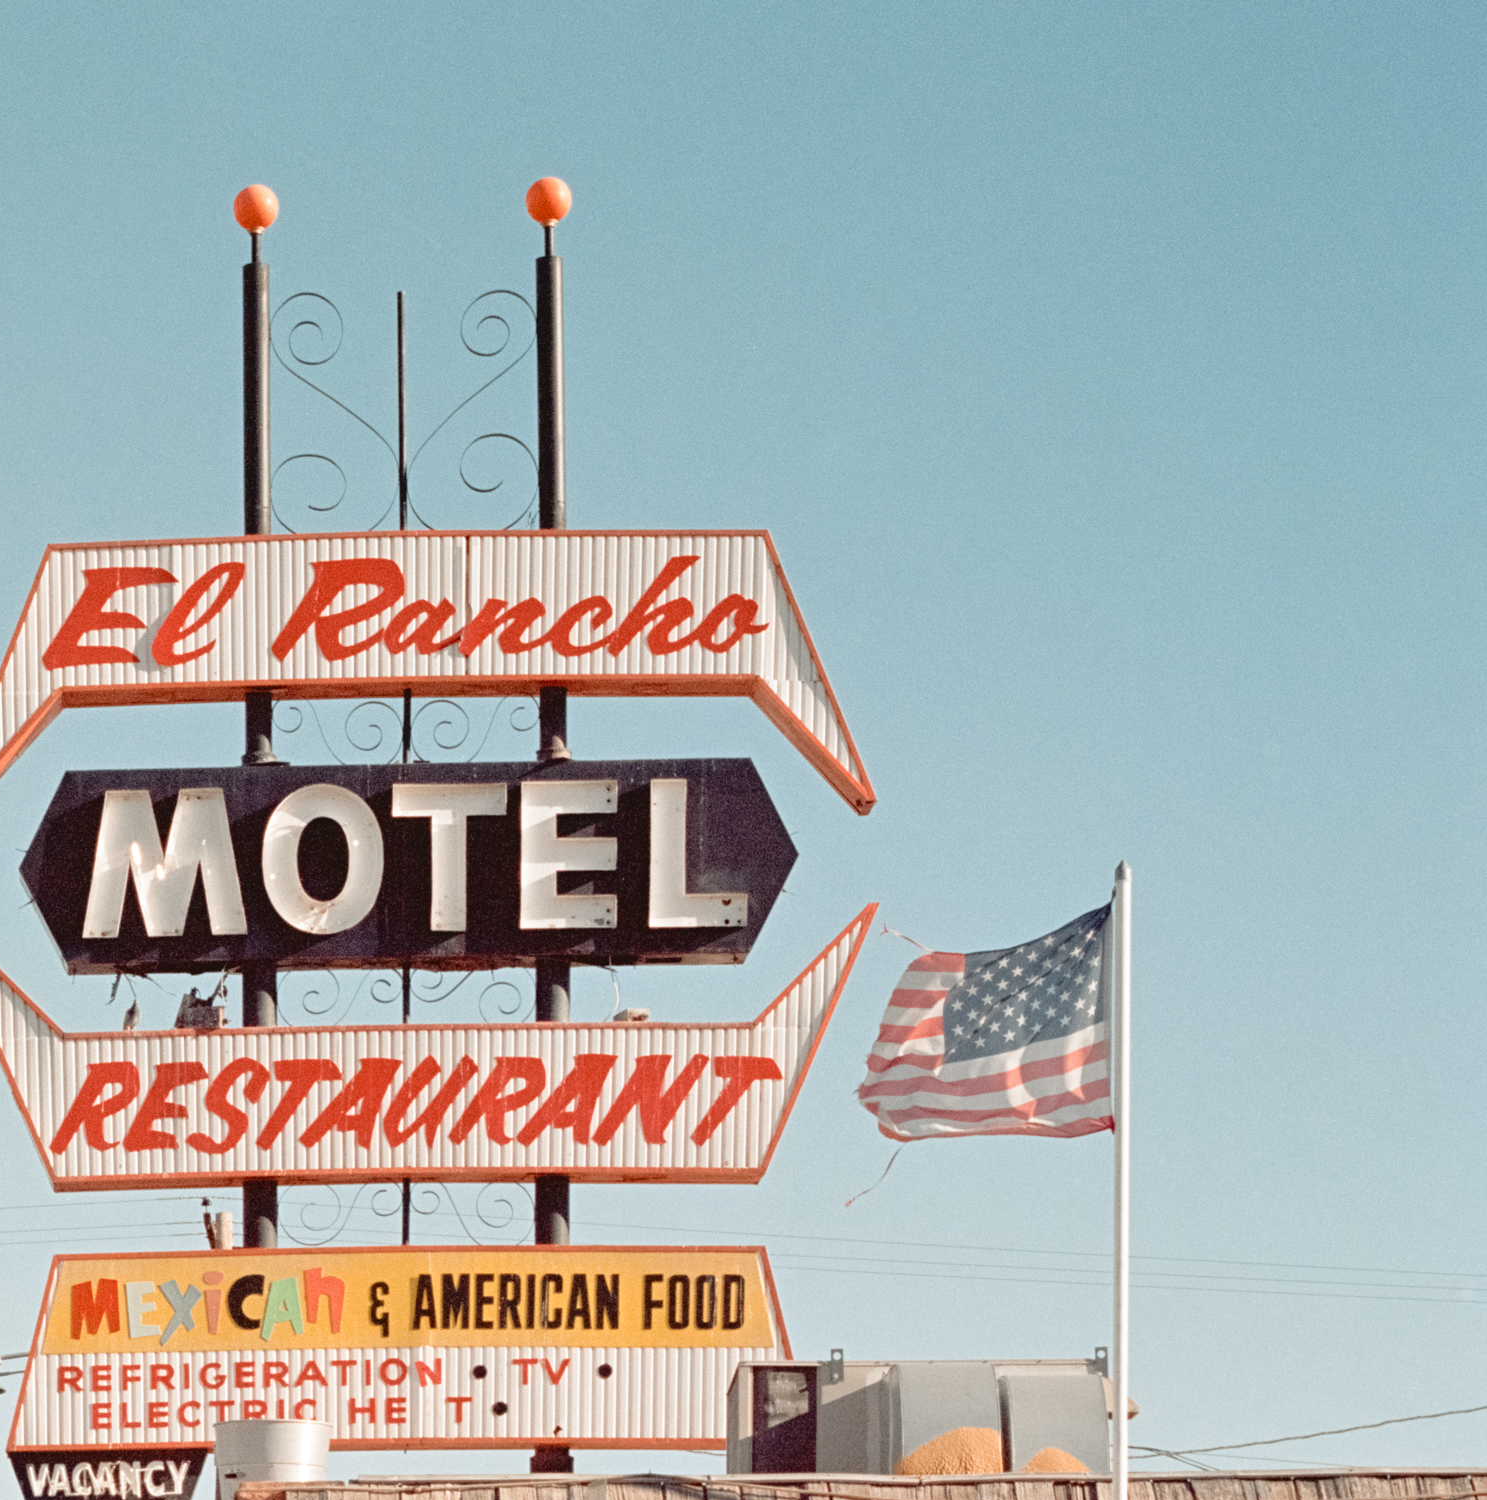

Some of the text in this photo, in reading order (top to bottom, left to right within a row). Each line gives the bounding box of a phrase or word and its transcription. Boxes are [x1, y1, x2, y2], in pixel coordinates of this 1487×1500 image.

[44, 555, 769, 670] El Rancho
[82, 778, 749, 940] MOTEL
[50, 1053, 783, 1154] RESTAURANT
[369, 1280, 391, 1338] &
[411, 1273, 621, 1331] AMERICAN
[643, 1273, 746, 1331] FOOD
[58, 1358, 571, 1393] REFRIGERATION TV
[91, 1398, 318, 1430] ELECTRIC
[26, 1460, 191, 1500] VACANCY
